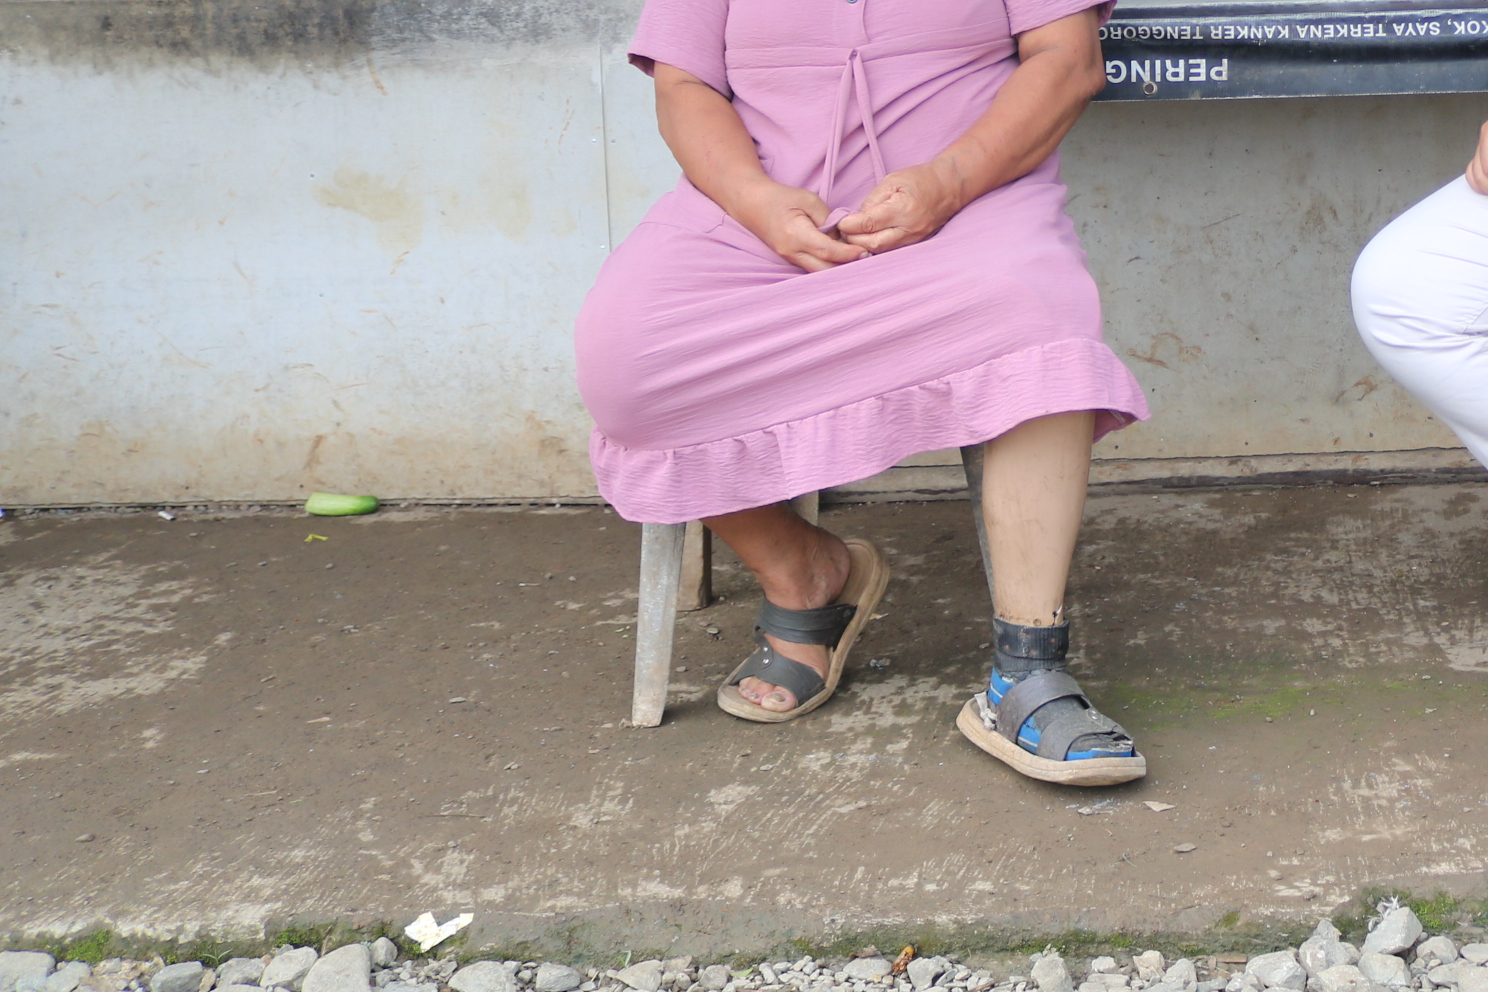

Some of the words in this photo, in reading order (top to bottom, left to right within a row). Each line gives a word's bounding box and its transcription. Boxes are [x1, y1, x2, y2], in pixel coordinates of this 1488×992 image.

[1211, 23, 1290, 40] KANKER
[1296, 22, 1387, 39] TERKENA
[1392, 21, 1441, 37] SAYA
